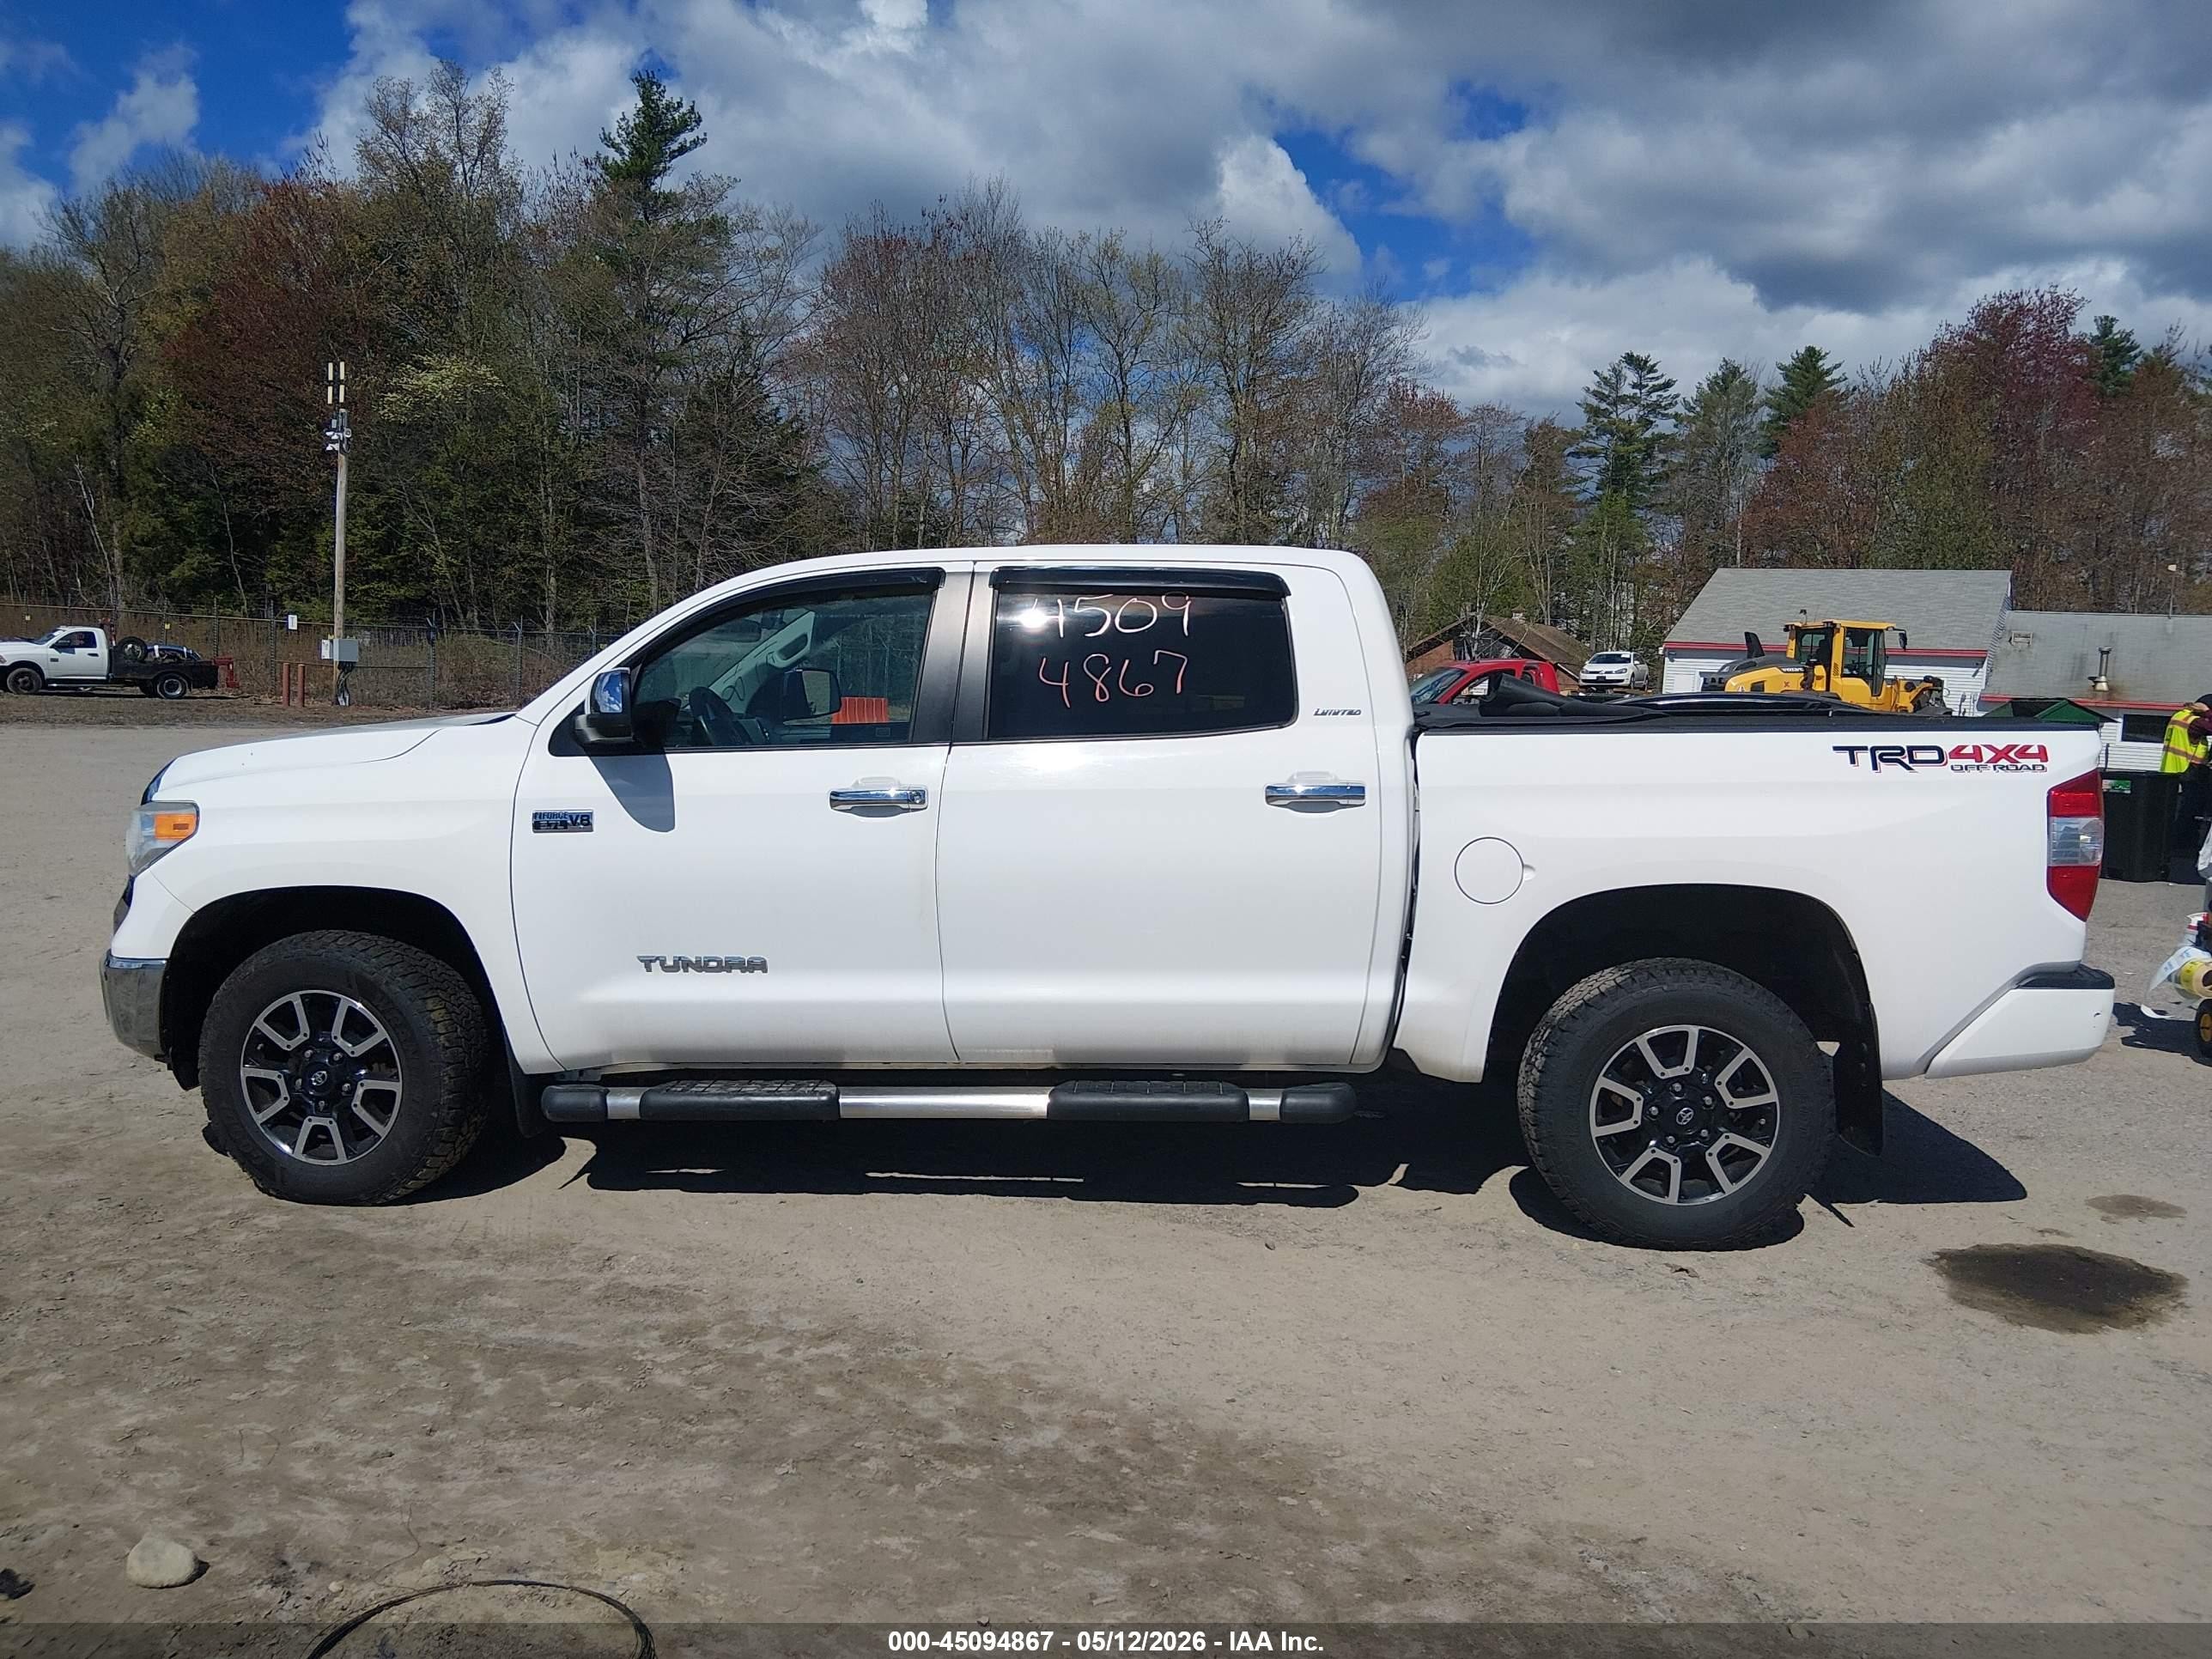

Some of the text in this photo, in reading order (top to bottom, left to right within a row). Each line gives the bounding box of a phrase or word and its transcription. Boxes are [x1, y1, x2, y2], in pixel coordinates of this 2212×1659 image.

[1023, 592, 1192, 638] 4509
[1039, 649, 1188, 708] 4867
[1832, 744, 1948, 773] TRD
[1950, 763, 2048, 773] OFF ROAD
[568, 814, 591, 826] V8
[636, 955, 769, 974] TUNDRA
